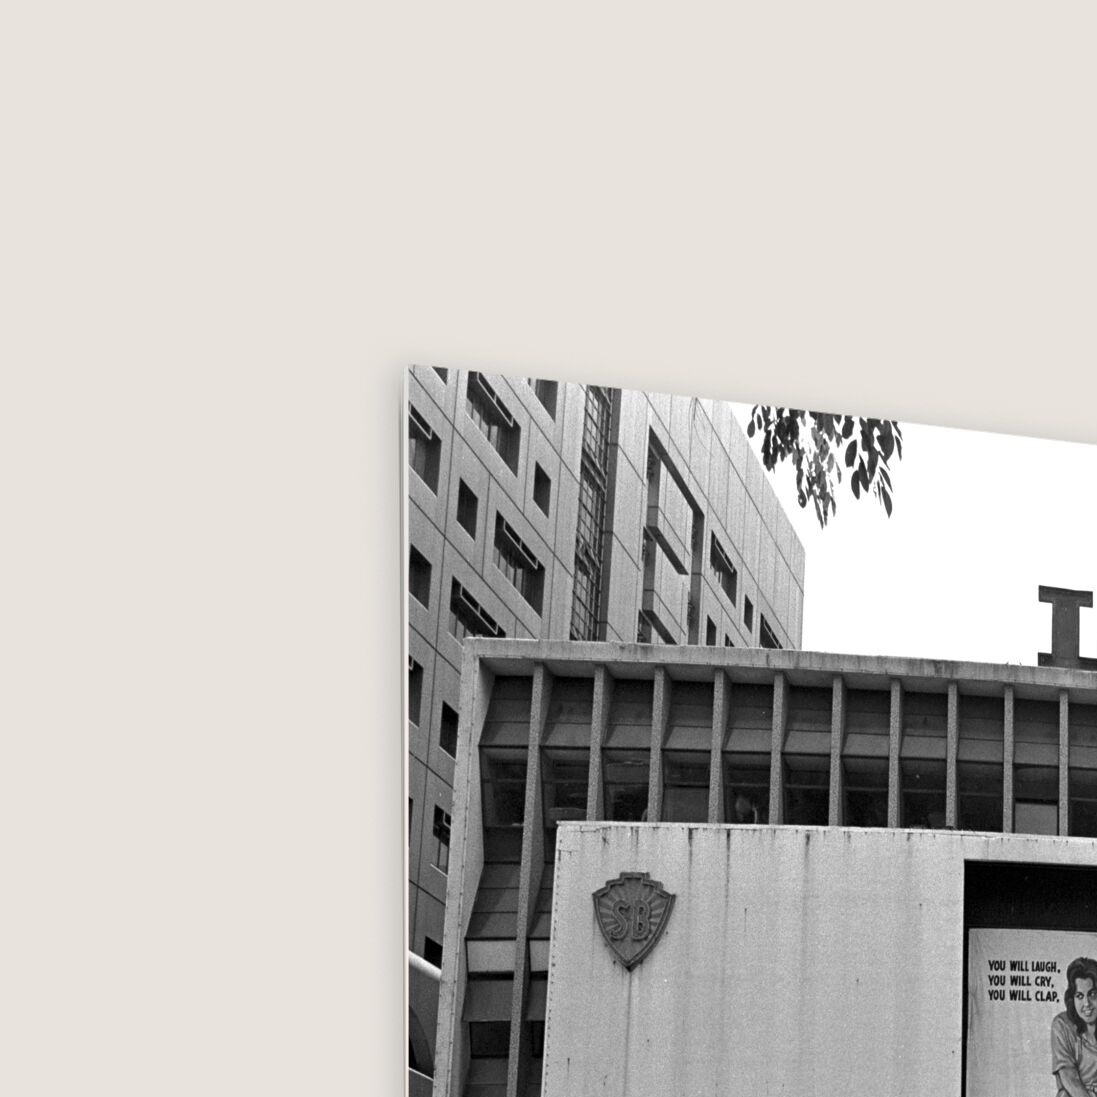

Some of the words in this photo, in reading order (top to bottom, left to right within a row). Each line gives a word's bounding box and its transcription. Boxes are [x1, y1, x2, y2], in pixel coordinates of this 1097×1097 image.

[611, 899, 652, 941] SB
[988, 960, 1006, 971] YOU
[1009, 960, 1029, 972] WILL
[988, 975, 1006, 987] YOU
[1010, 975, 1031, 987] WILL
[988, 989, 1005, 1001] YOU
[1009, 990, 1032, 1001] WILL
